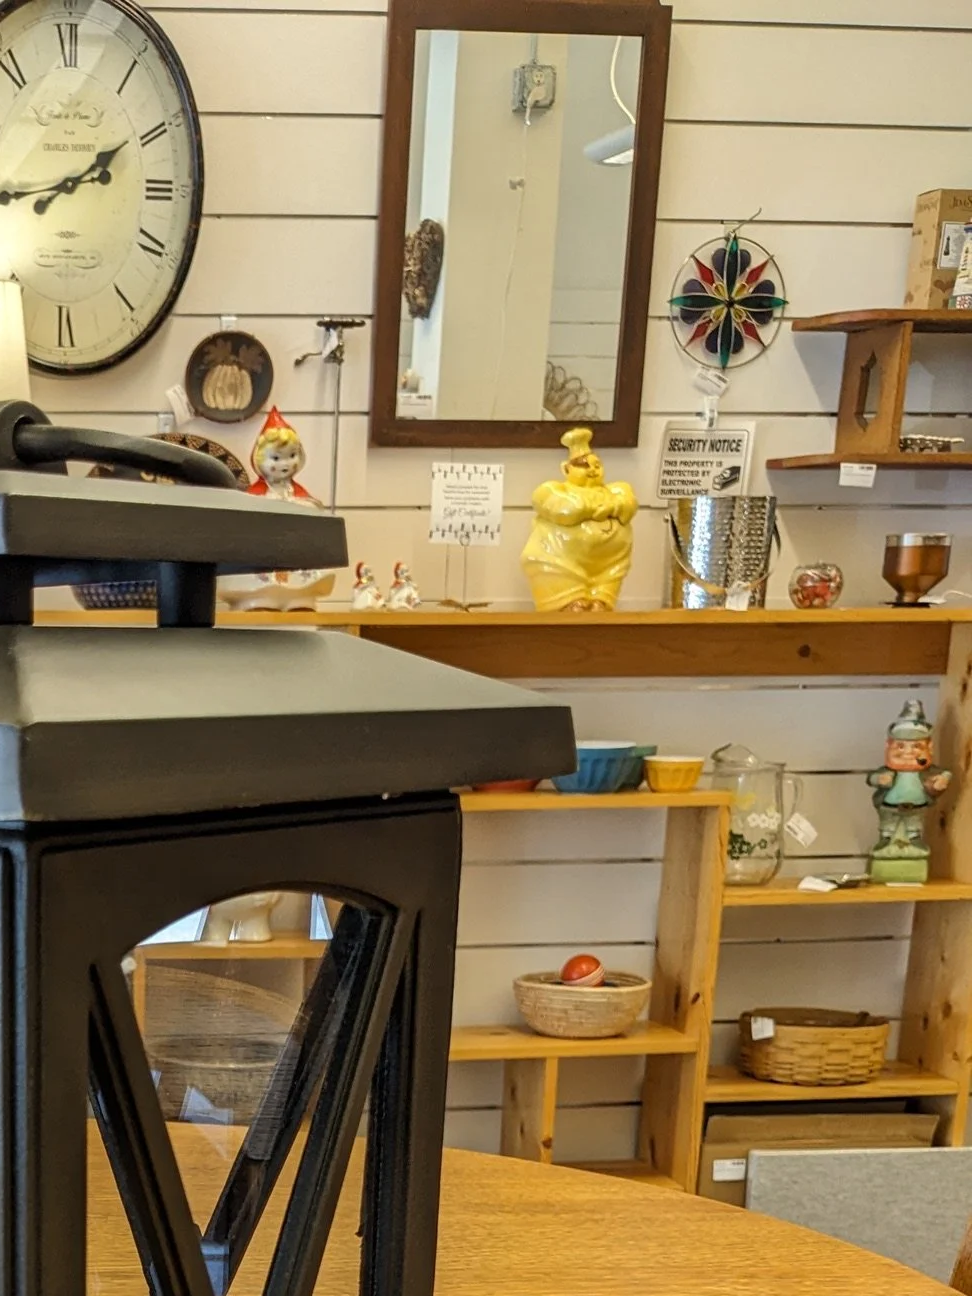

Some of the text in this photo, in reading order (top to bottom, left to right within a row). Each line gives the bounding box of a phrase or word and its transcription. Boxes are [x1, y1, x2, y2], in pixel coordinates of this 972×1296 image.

[668, 438, 743, 453] SECURITY NOTICE
[679, 459, 715, 468] PROPERTY
[661, 469, 701, 477] PROTECTED
[660, 479, 702, 487] ELECTRONIC
